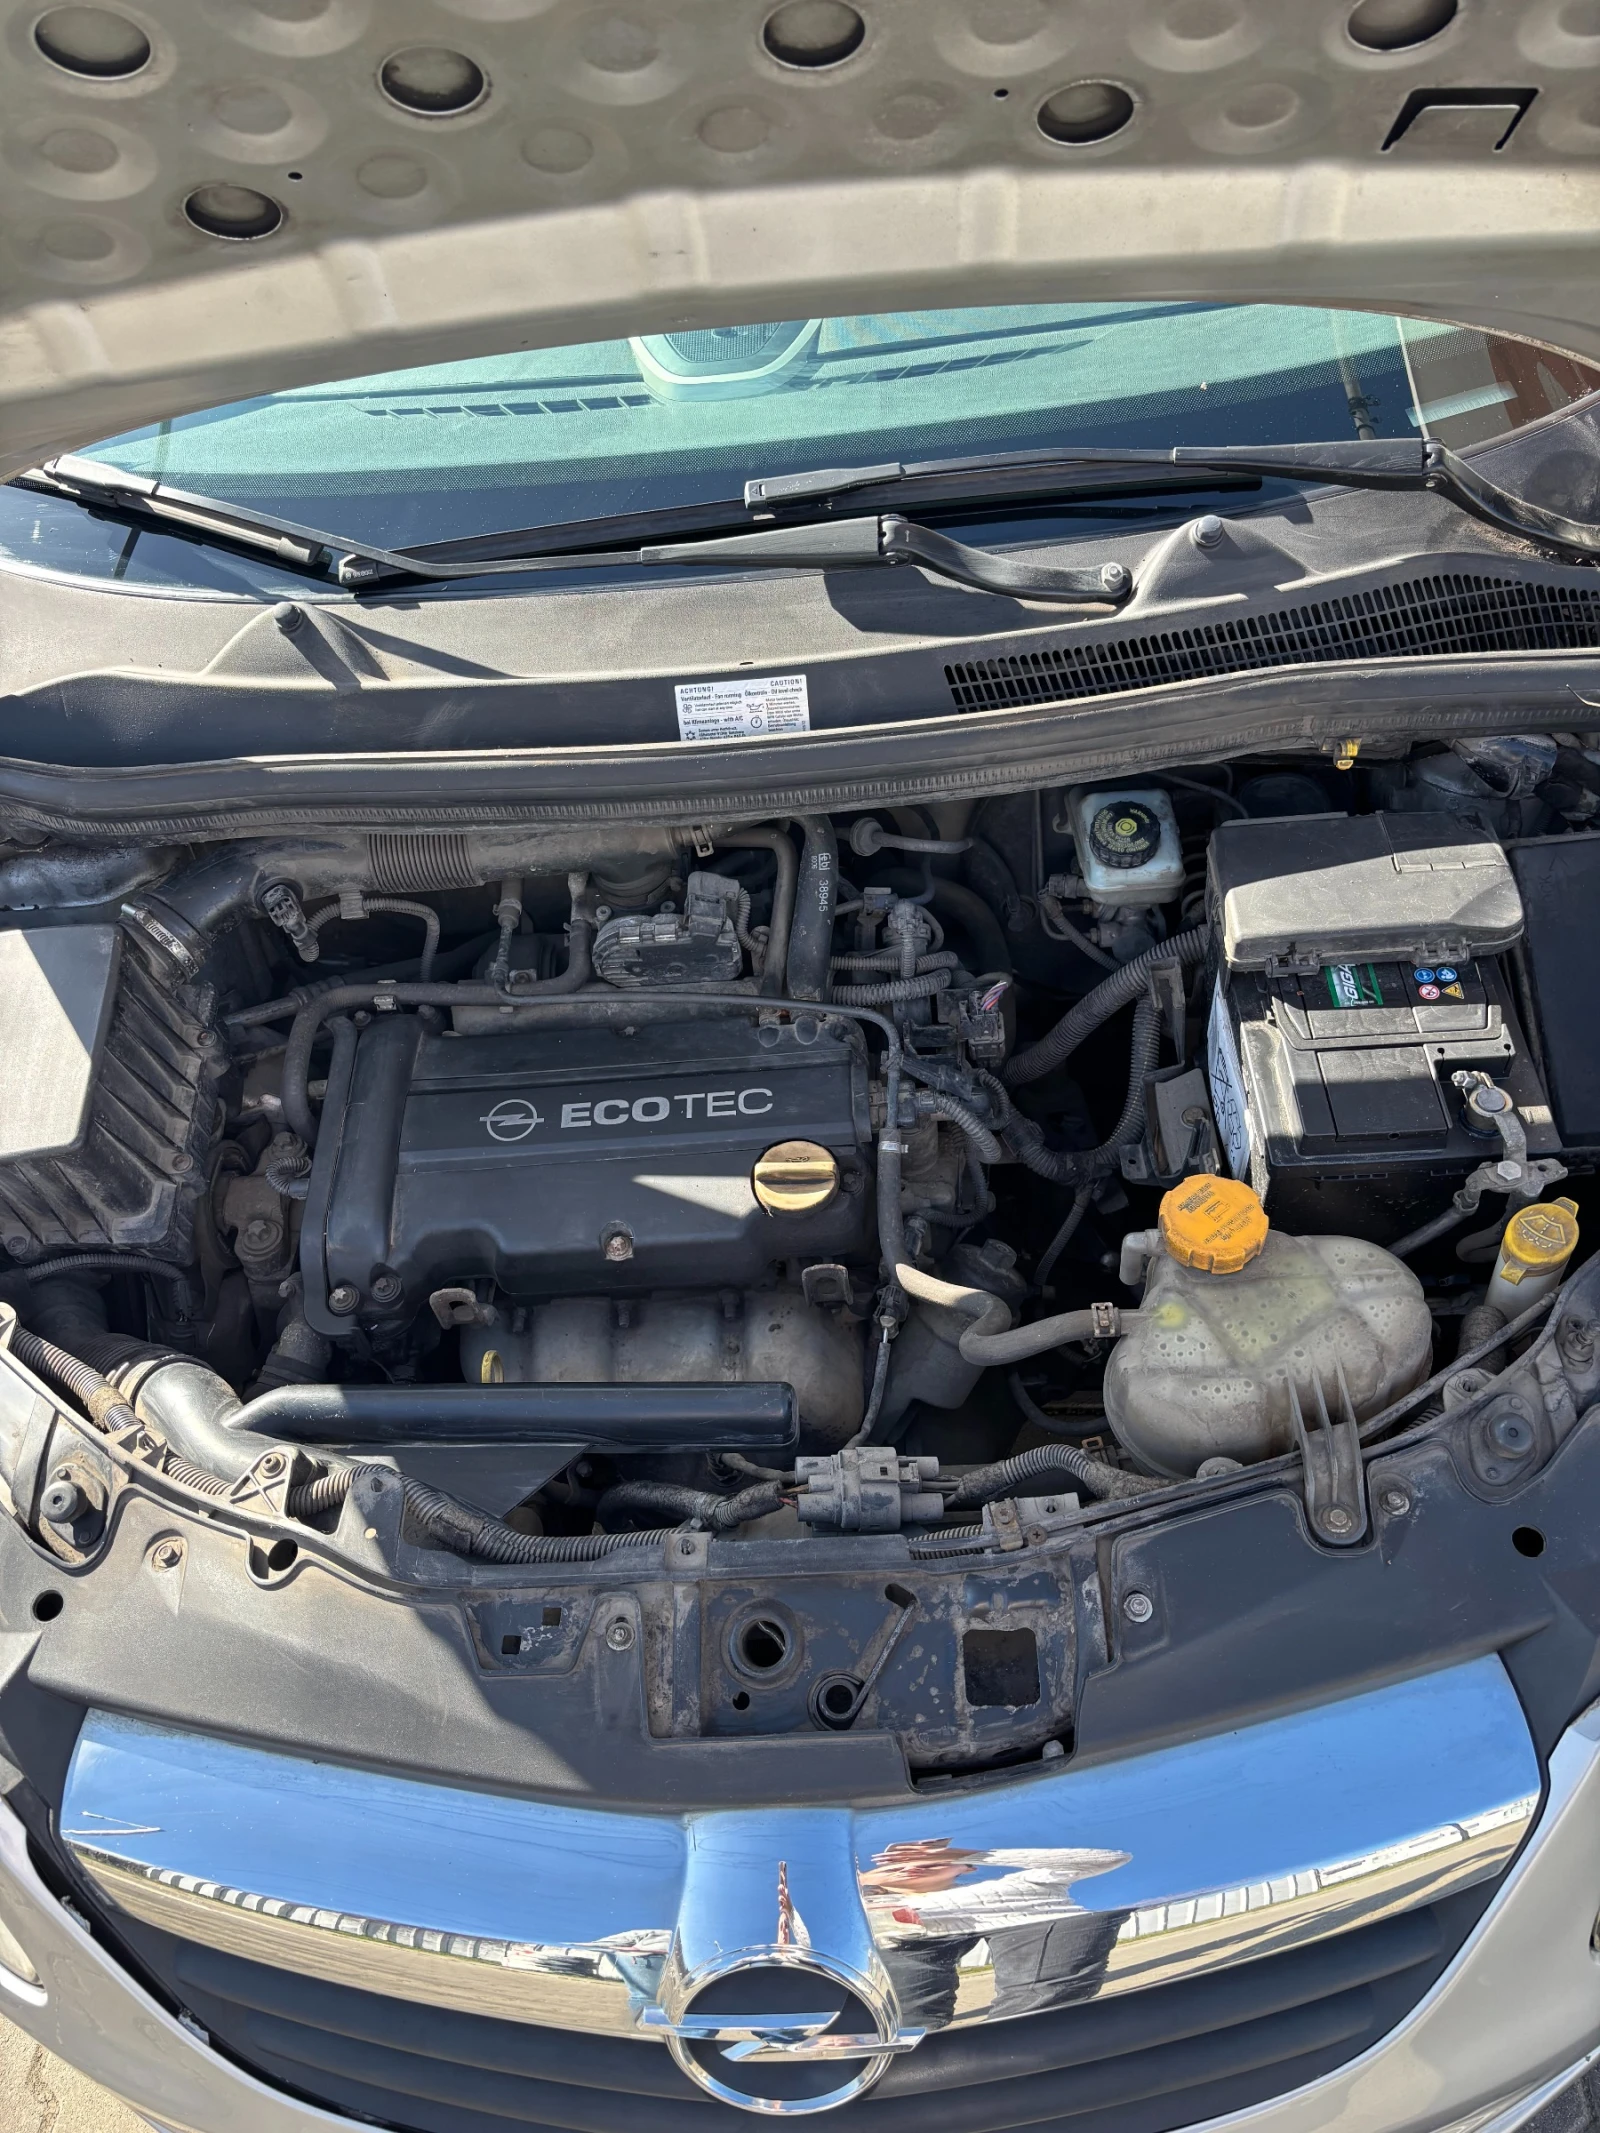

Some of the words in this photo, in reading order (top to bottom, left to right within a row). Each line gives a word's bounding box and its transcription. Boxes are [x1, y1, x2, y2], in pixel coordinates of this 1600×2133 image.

[680, 686, 714, 694] ACHTUNG!
[770, 678, 803, 687] CAUTION!
[818, 879, 829, 912] 38945
[560, 1088, 774, 1128] ECOTEC
